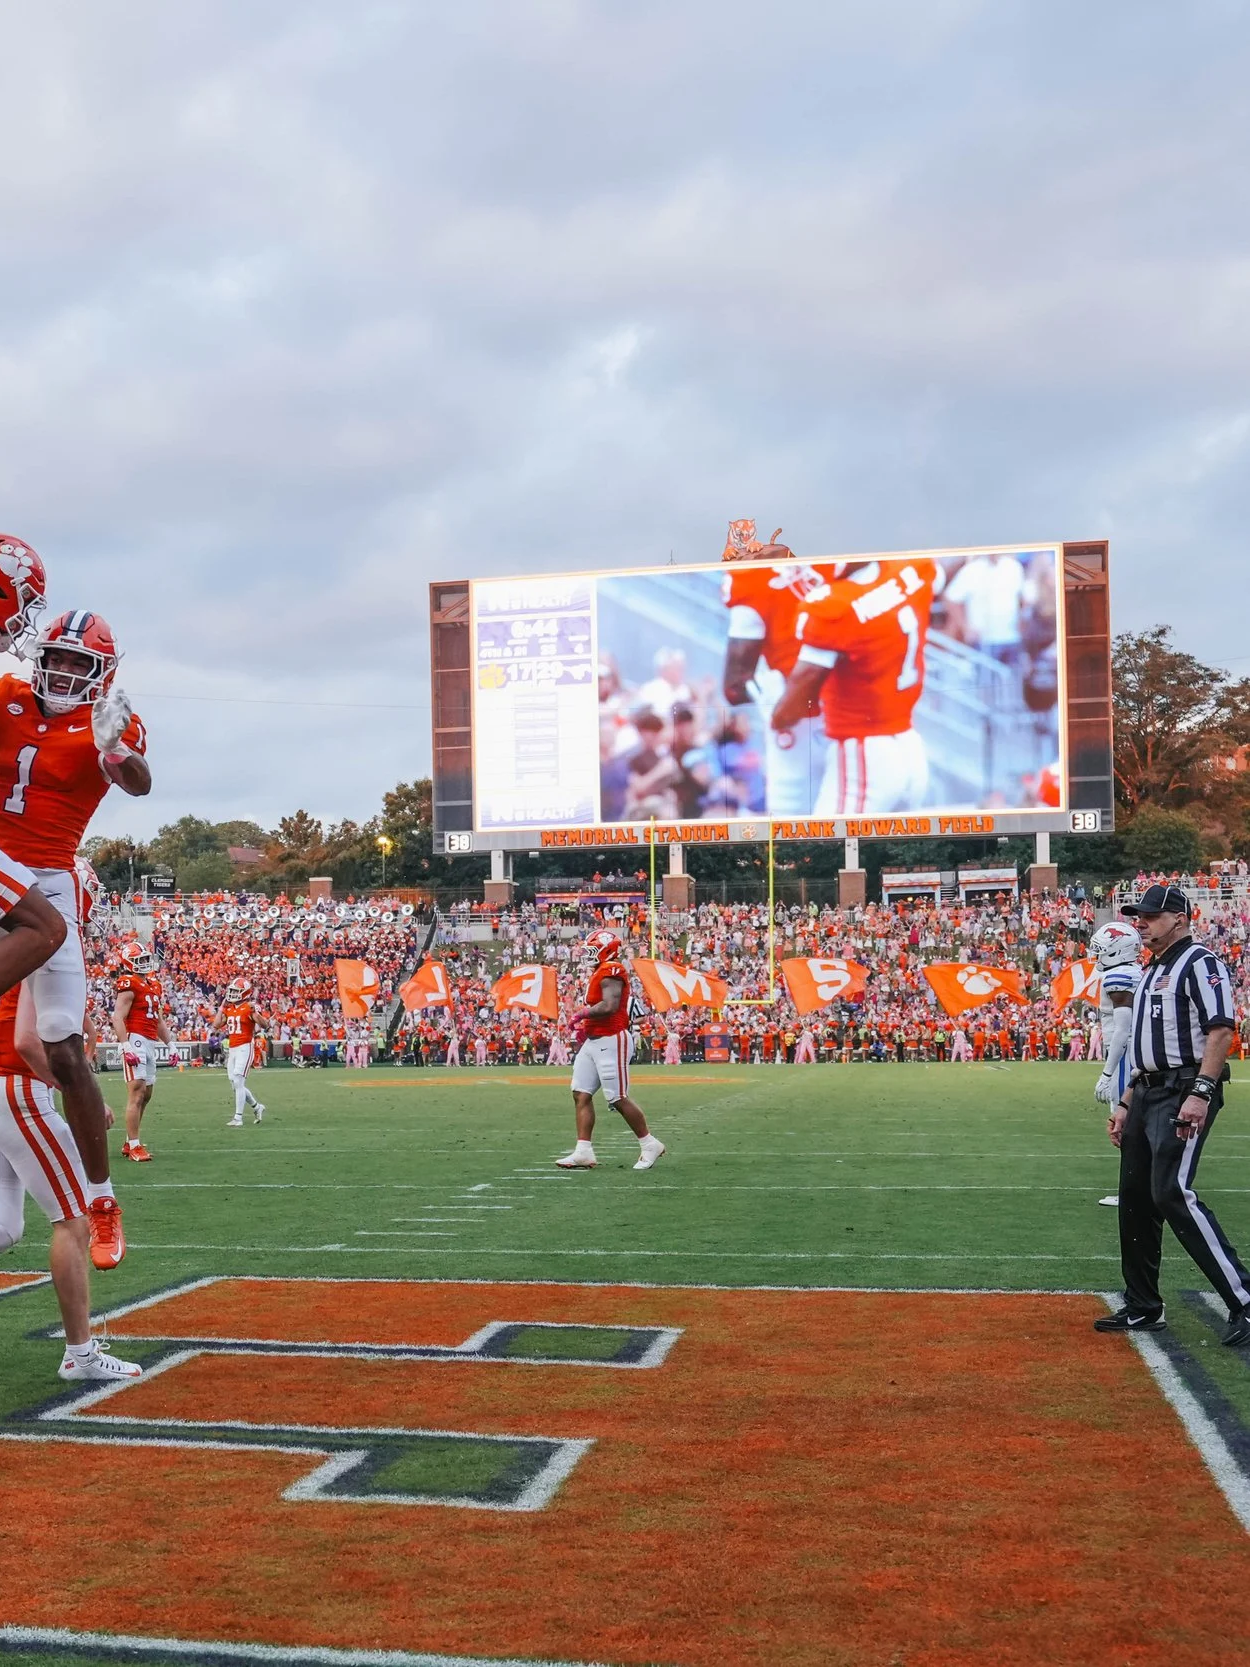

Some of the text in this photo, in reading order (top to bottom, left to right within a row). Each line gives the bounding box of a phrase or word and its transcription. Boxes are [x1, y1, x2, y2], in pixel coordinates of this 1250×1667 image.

[897, 605, 918, 691] 1
[507, 662, 531, 680] 17
[136, 723, 143, 749] 1
[3, 744, 39, 815] 1
[541, 815, 994, 847] MEMORIAL STADIUM FRANK HOWARD FIELD
[1073, 813, 1096, 830] 38
[449, 835, 469, 850] 38
[654, 961, 712, 1004] M
[1151, 1004, 1161, 1018] F
